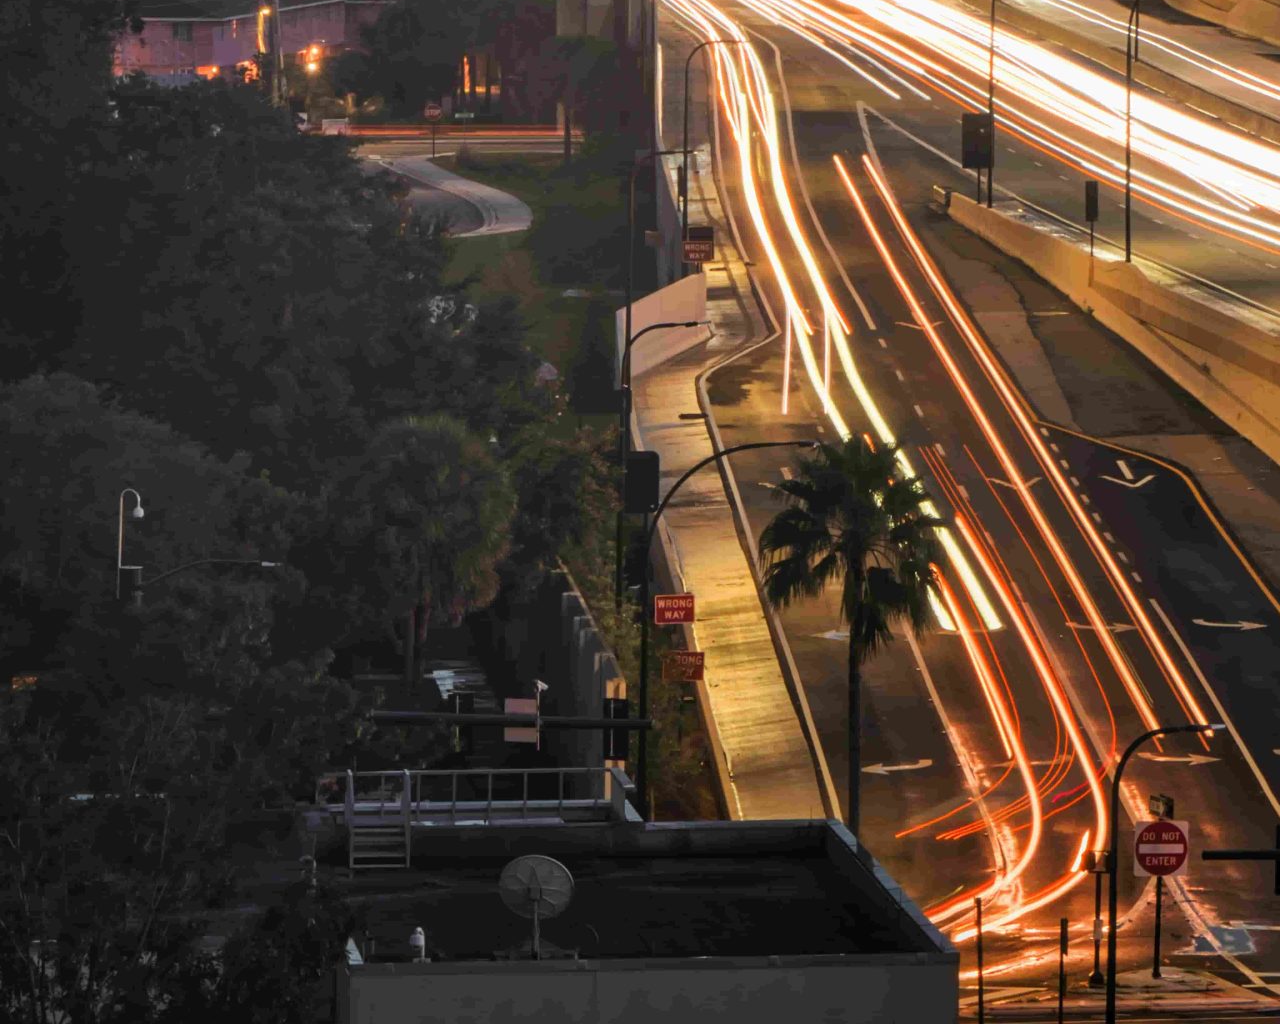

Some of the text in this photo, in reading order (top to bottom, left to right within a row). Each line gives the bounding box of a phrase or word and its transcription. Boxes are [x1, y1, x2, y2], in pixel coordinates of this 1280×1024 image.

[657, 599, 693, 608] WRONG
[664, 610, 685, 619] WAY
[1143, 832, 1180, 841] DO NOT
[1145, 856, 1176, 866] ENTER
